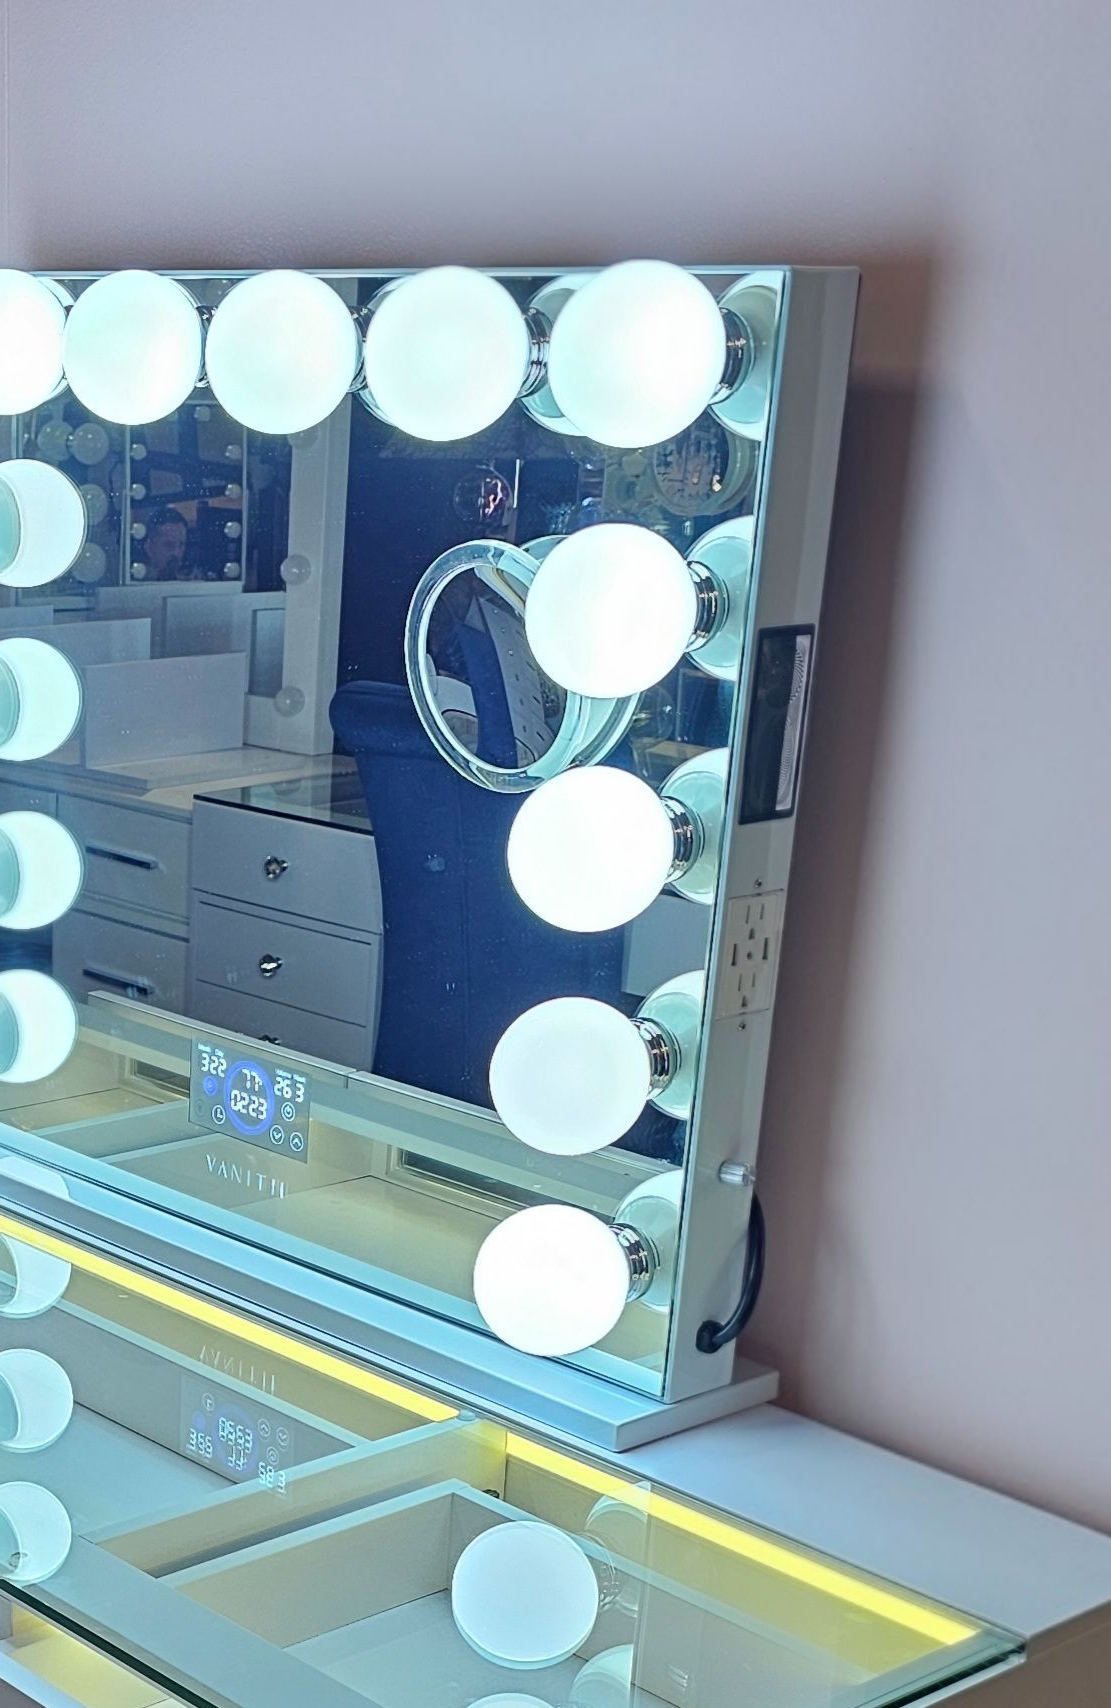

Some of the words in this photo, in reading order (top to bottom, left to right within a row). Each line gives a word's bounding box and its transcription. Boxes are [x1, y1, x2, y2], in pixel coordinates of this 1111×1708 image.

[273, 1076, 292, 1099] 26
[294, 1082, 305, 1103] 3
[230, 1089, 268, 1120] 0223
